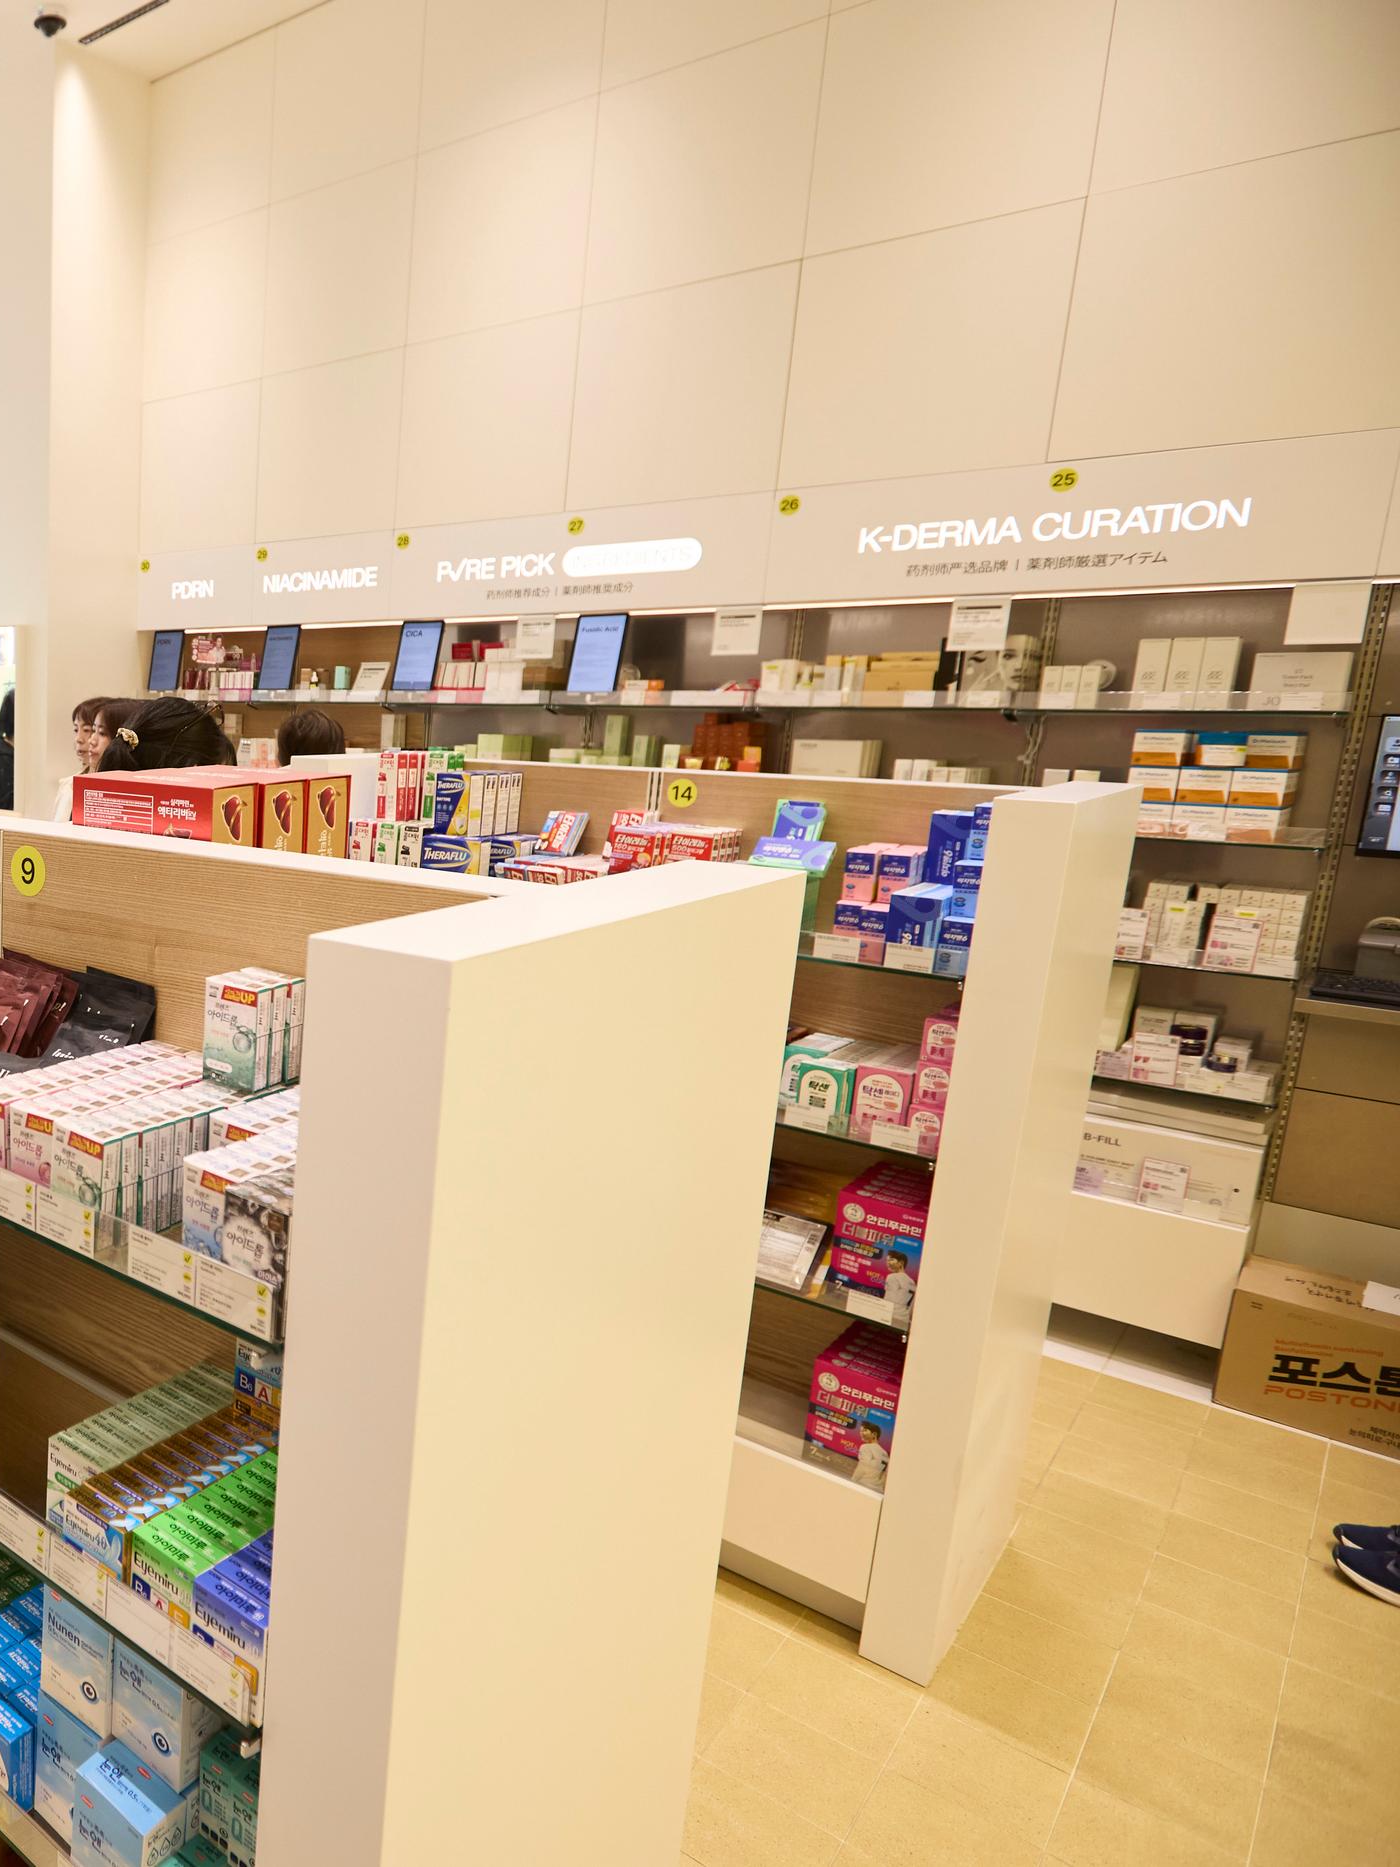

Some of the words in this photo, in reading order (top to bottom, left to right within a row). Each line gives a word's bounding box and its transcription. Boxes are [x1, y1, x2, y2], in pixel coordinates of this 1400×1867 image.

[1052, 473, 1076, 487] 25
[781, 498, 798, 512] 26
[569, 520, 583, 531] 27
[858, 515, 1023, 554] K-DERMA
[1032, 497, 1252, 541] CURATION
[398, 536, 409, 547] 28
[257, 549, 267, 559] 29
[141, 561, 149, 570] 30
[500, 552, 556, 578] PICK
[171, 580, 214, 600] PDRN
[263, 566, 378, 594] NIACINAMIDE
[406, 630, 423, 638] CICA
[437, 781, 464, 790] THERAFLU
[671, 786, 693, 800] 14
[424, 848, 467, 861] THERAFLU
[21, 857, 35, 885] 9
[1083, 1132, 1122, 1147] B-FILL
[866, 1214, 922, 1237] 안티푸라민
[227, 1232, 265, 1259] 아이드롭
[258, 1386, 269, 1402] A
[840, 1384, 895, 1409] 안티푸라민
[50, 1452, 77, 1477] Eyemiru
[65, 1514, 95, 1543] Eyemiru
[134, 1551, 179, 1596] Eyemiru
[48, 1611, 81, 1648] Nunen
[195, 1602, 246, 1650] Eyemiru
